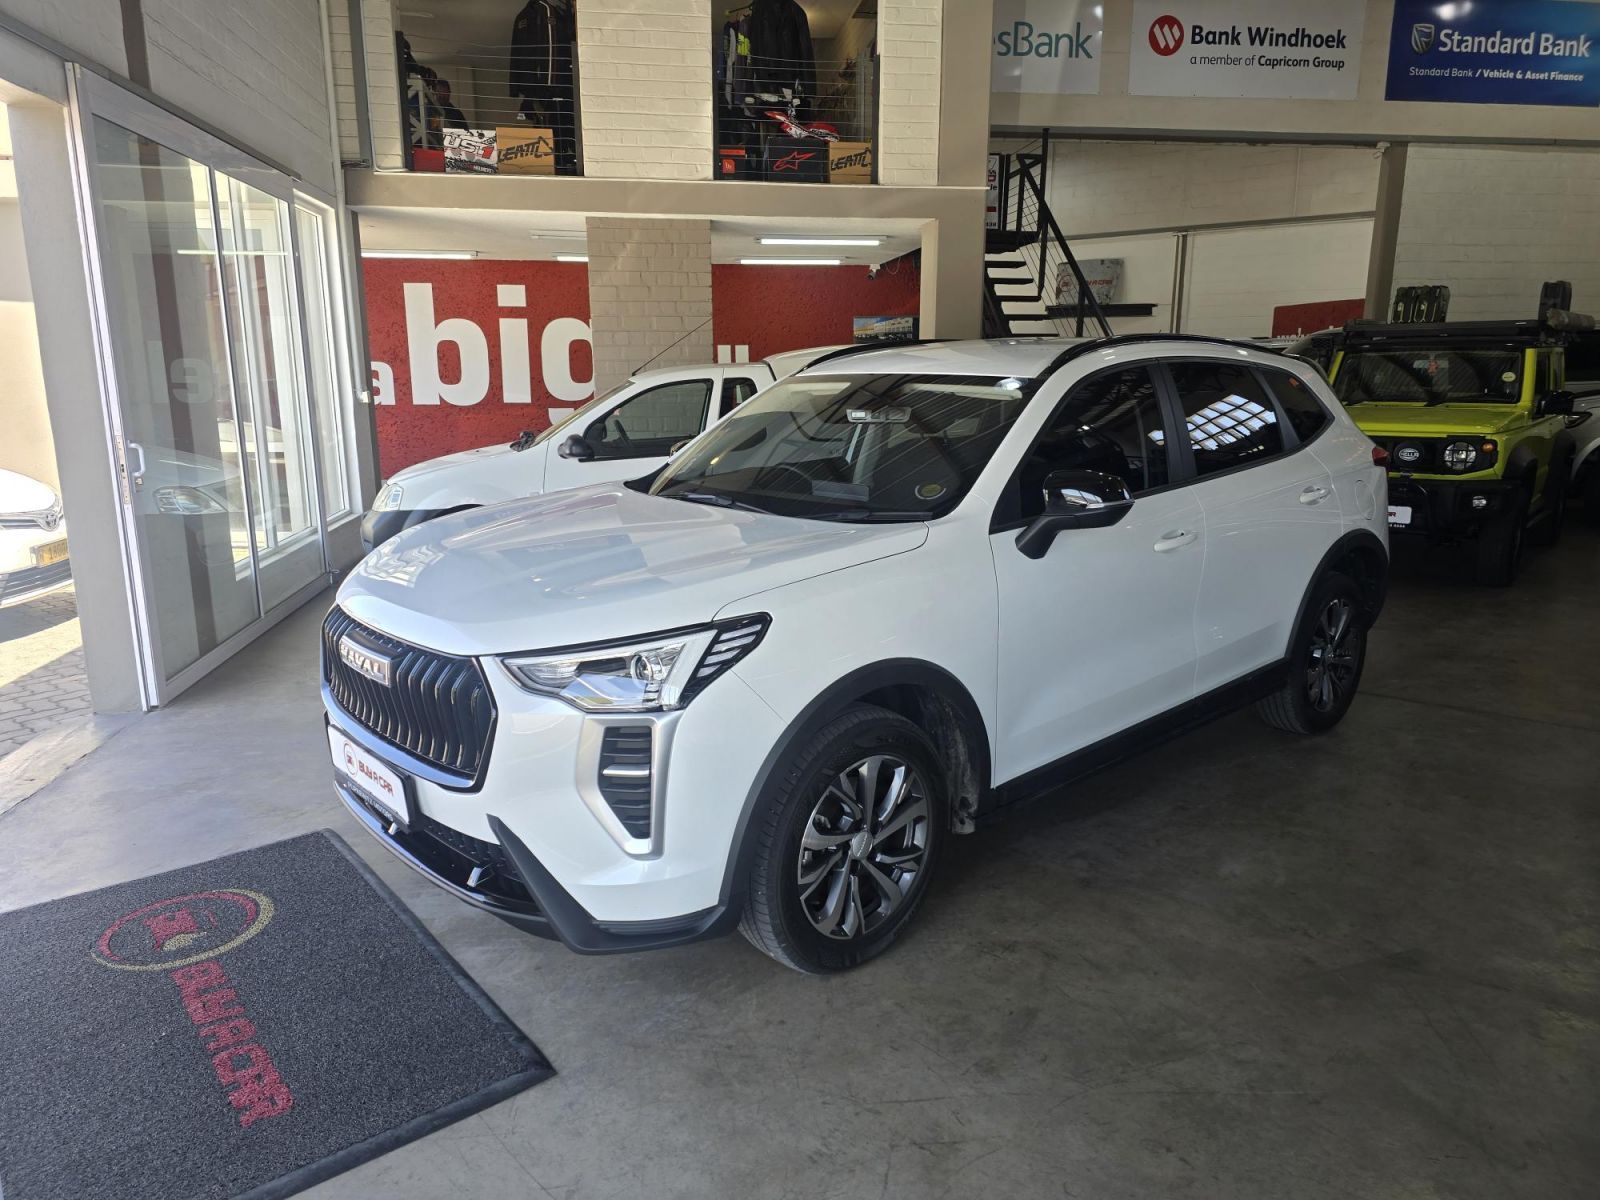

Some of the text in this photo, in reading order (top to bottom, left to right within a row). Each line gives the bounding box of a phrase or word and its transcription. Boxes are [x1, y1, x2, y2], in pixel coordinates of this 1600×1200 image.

[994, 21, 1093, 59] sBank
[1191, 25, 1346, 49] Bank Windhoek
[1438, 28, 1592, 58] Standard Bank
[1190, 53, 1345, 71] a member of Capricorn Group
[1409, 66, 1450, 77] Standard
[1451, 68, 1473, 77] Bank
[1483, 69, 1514, 79] Vehicle
[1516, 70, 1524, 79] &
[1525, 71, 1548, 80] Asset
[1550, 71, 1584, 82] Finance
[341, 644, 386, 682] HAVAL
